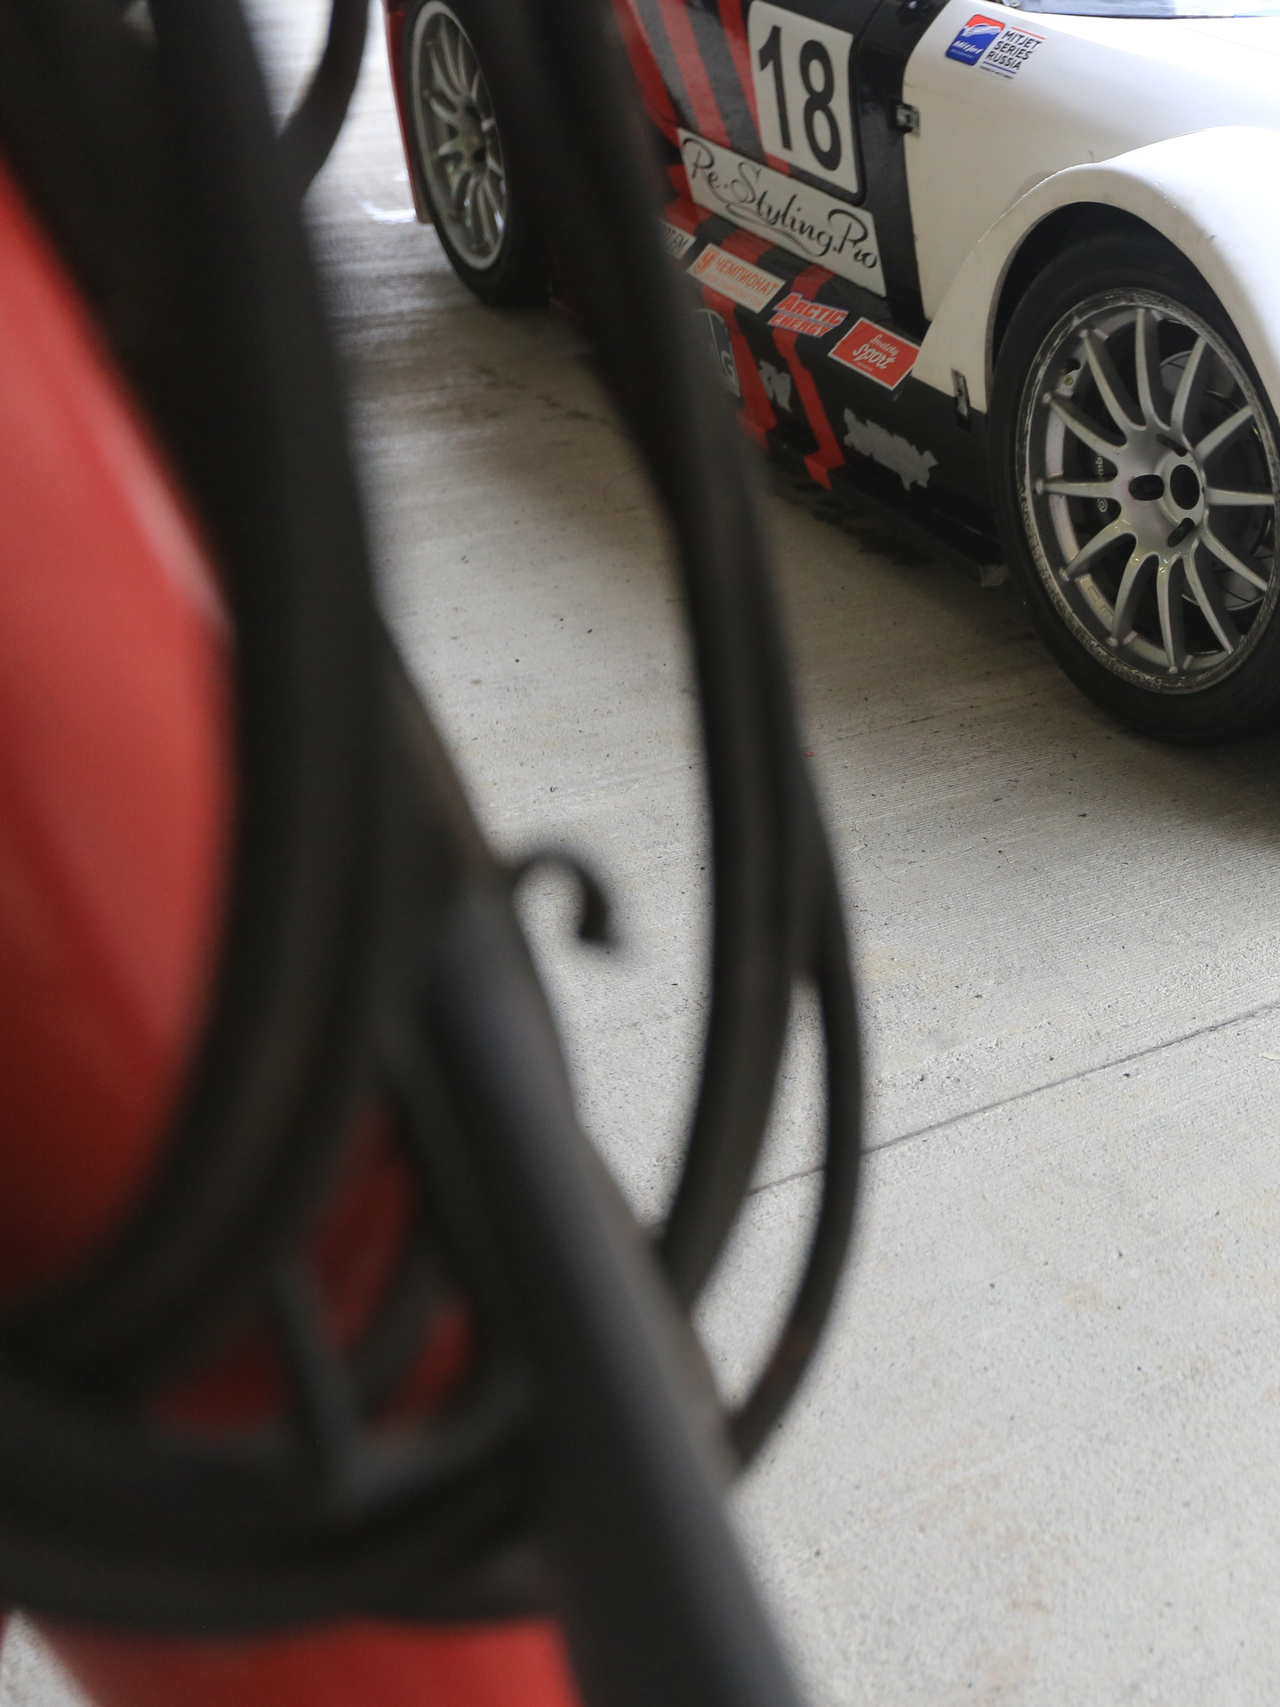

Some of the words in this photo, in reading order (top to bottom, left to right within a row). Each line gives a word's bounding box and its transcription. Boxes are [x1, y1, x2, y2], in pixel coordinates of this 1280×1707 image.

[1001, 30, 1042, 50] MITJET
[986, 51, 1022, 70] RUSSIA
[994, 41, 1032, 60] SERIES
[758, 24, 842, 171] 18
[715, 255, 779, 297] ЧЕМПИОНАТ
